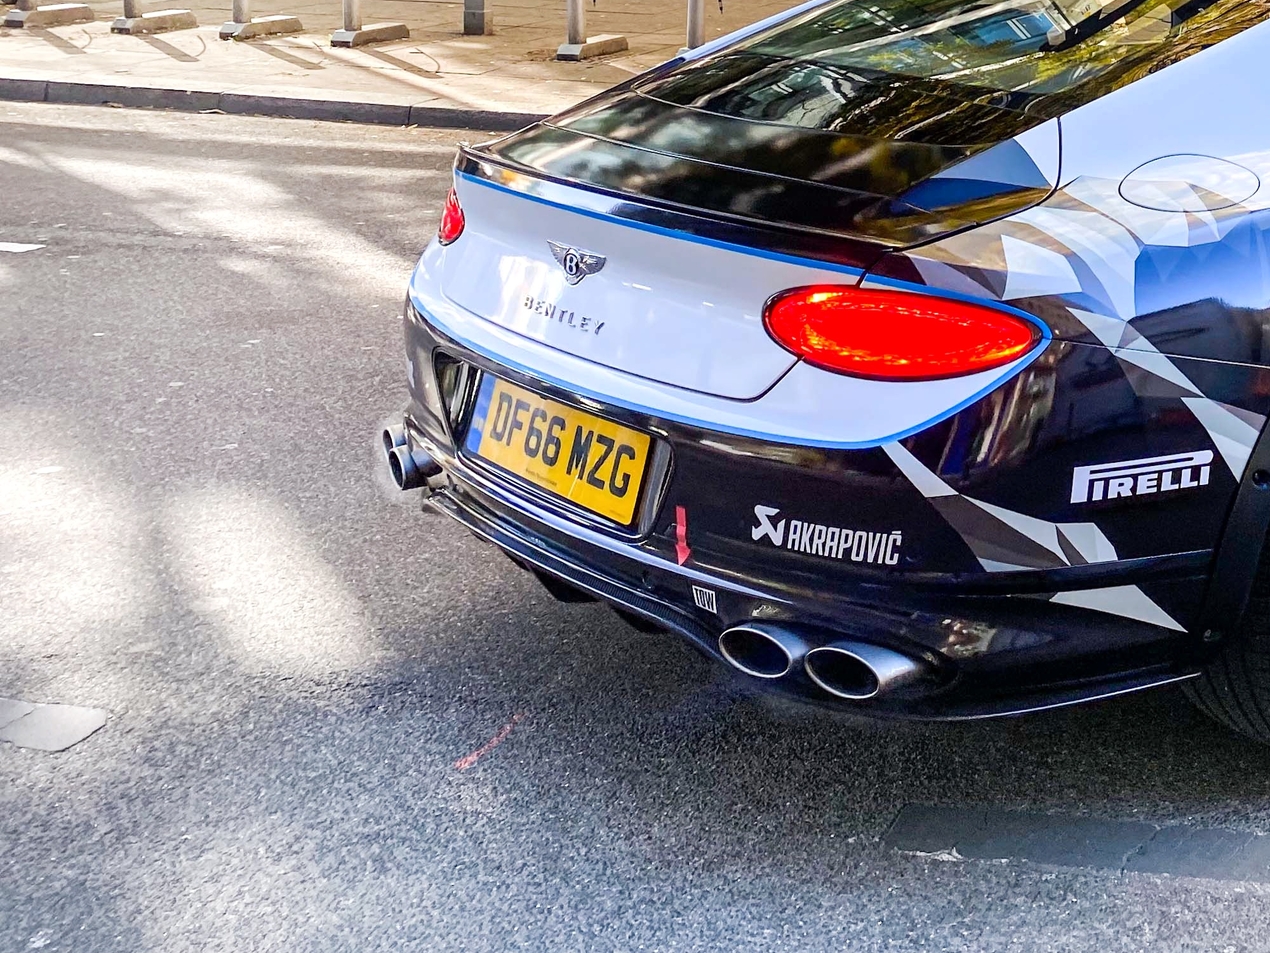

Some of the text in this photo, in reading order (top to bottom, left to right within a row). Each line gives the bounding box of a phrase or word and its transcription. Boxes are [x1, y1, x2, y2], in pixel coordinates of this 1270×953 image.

[523, 294, 606, 335] BENTLEY
[489, 390, 636, 499] DF66 MZG
[1070, 449, 1214, 504] PIRELLI
[694, 587, 717, 612] TOW
